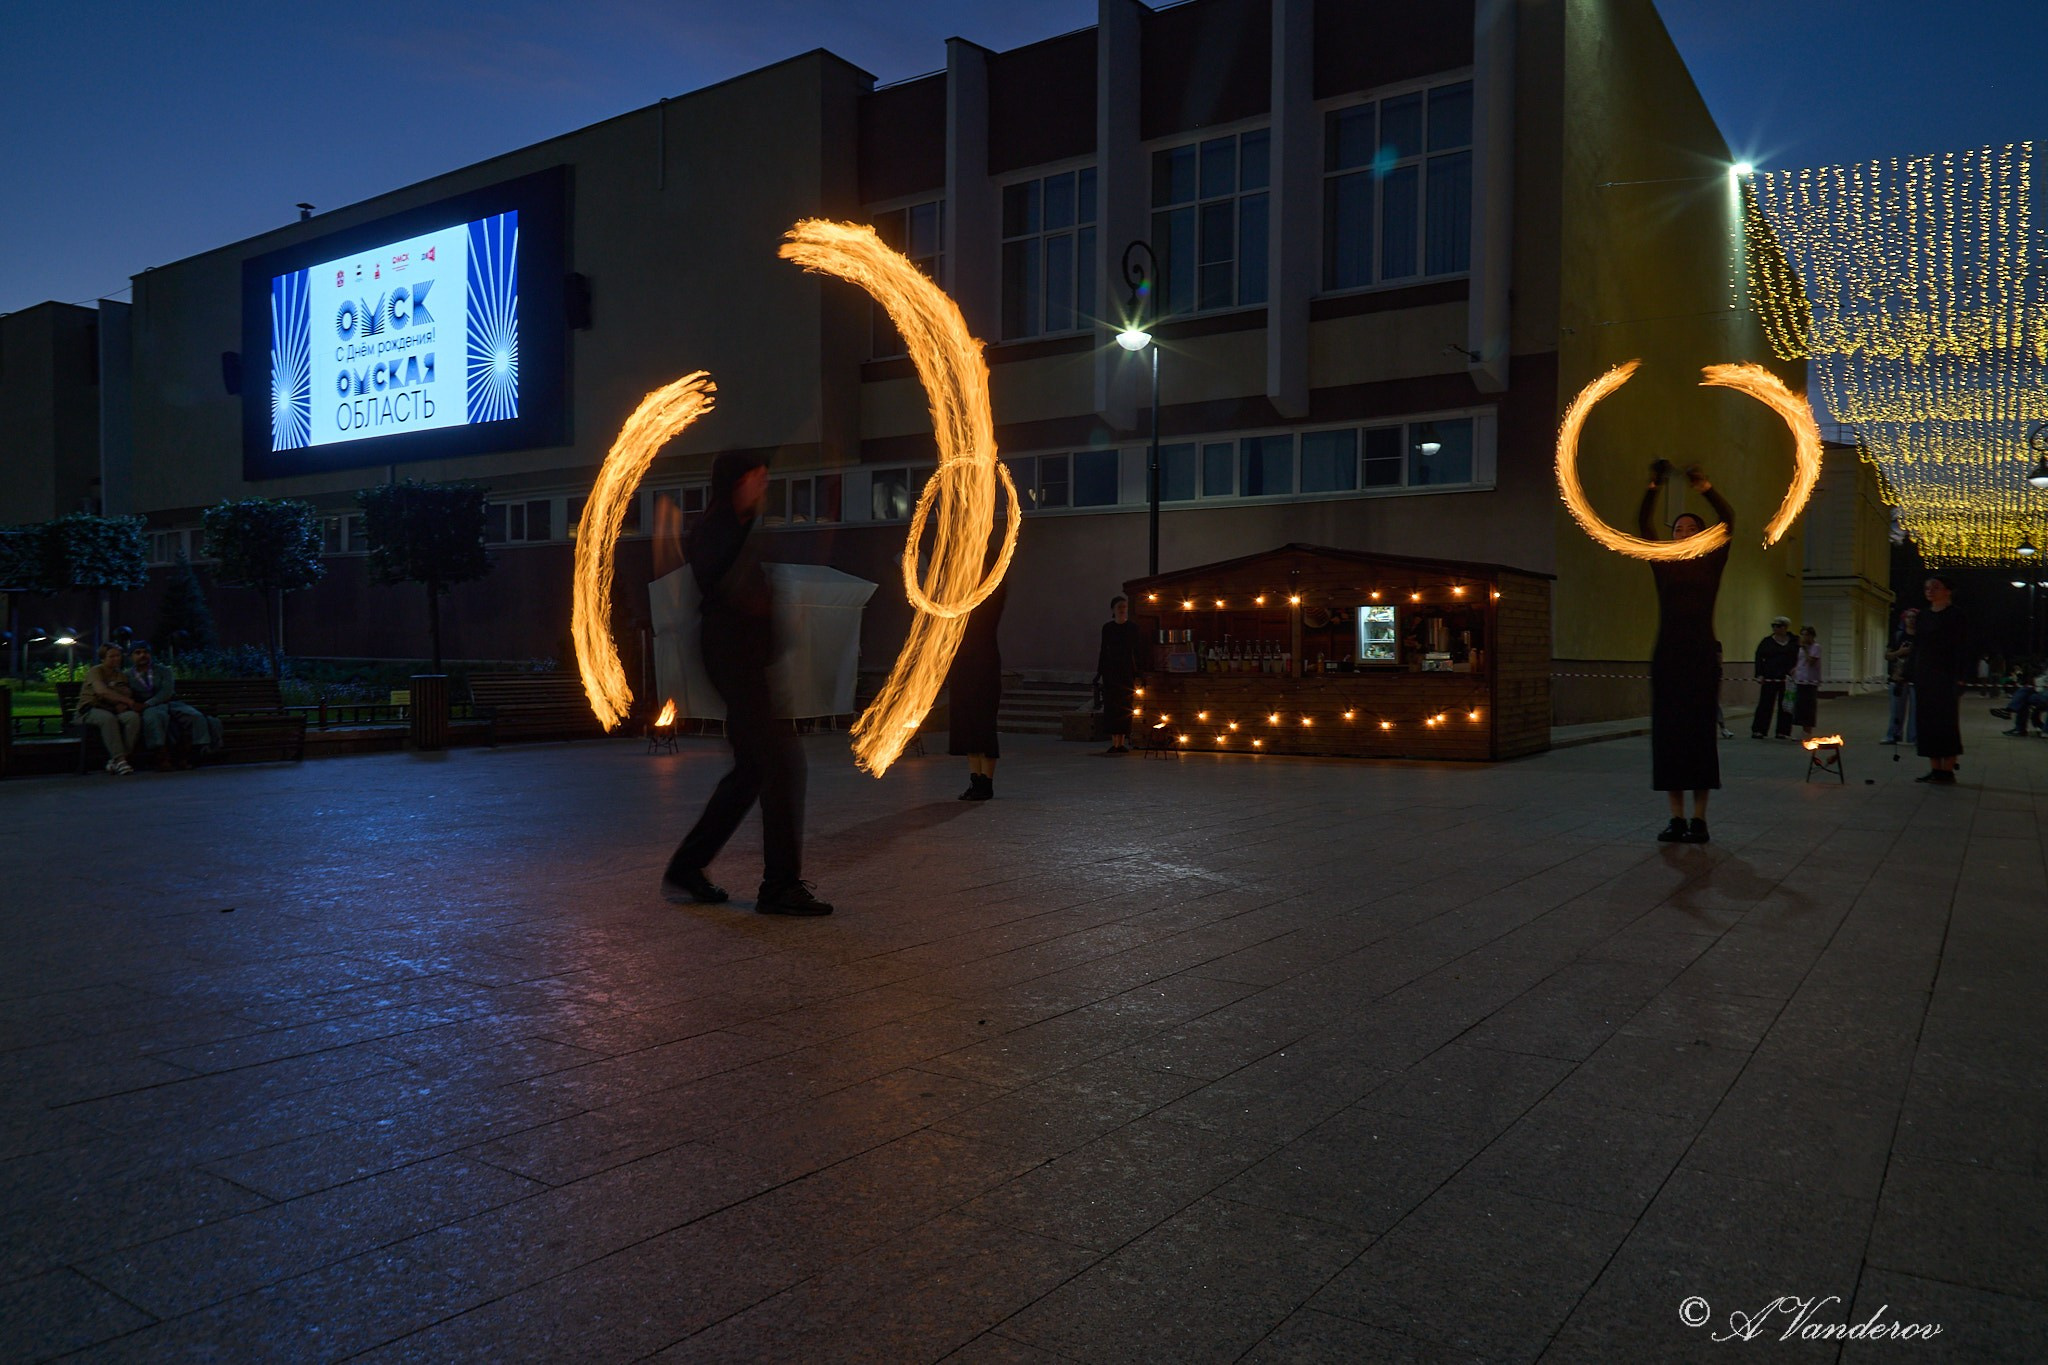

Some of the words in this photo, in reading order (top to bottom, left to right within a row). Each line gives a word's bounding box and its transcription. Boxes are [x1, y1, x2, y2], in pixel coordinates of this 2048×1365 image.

[346, 341, 375, 363] Днём
[377, 326, 436, 354] рождения!
[336, 389, 436, 431] ОБЛАСТЬ
